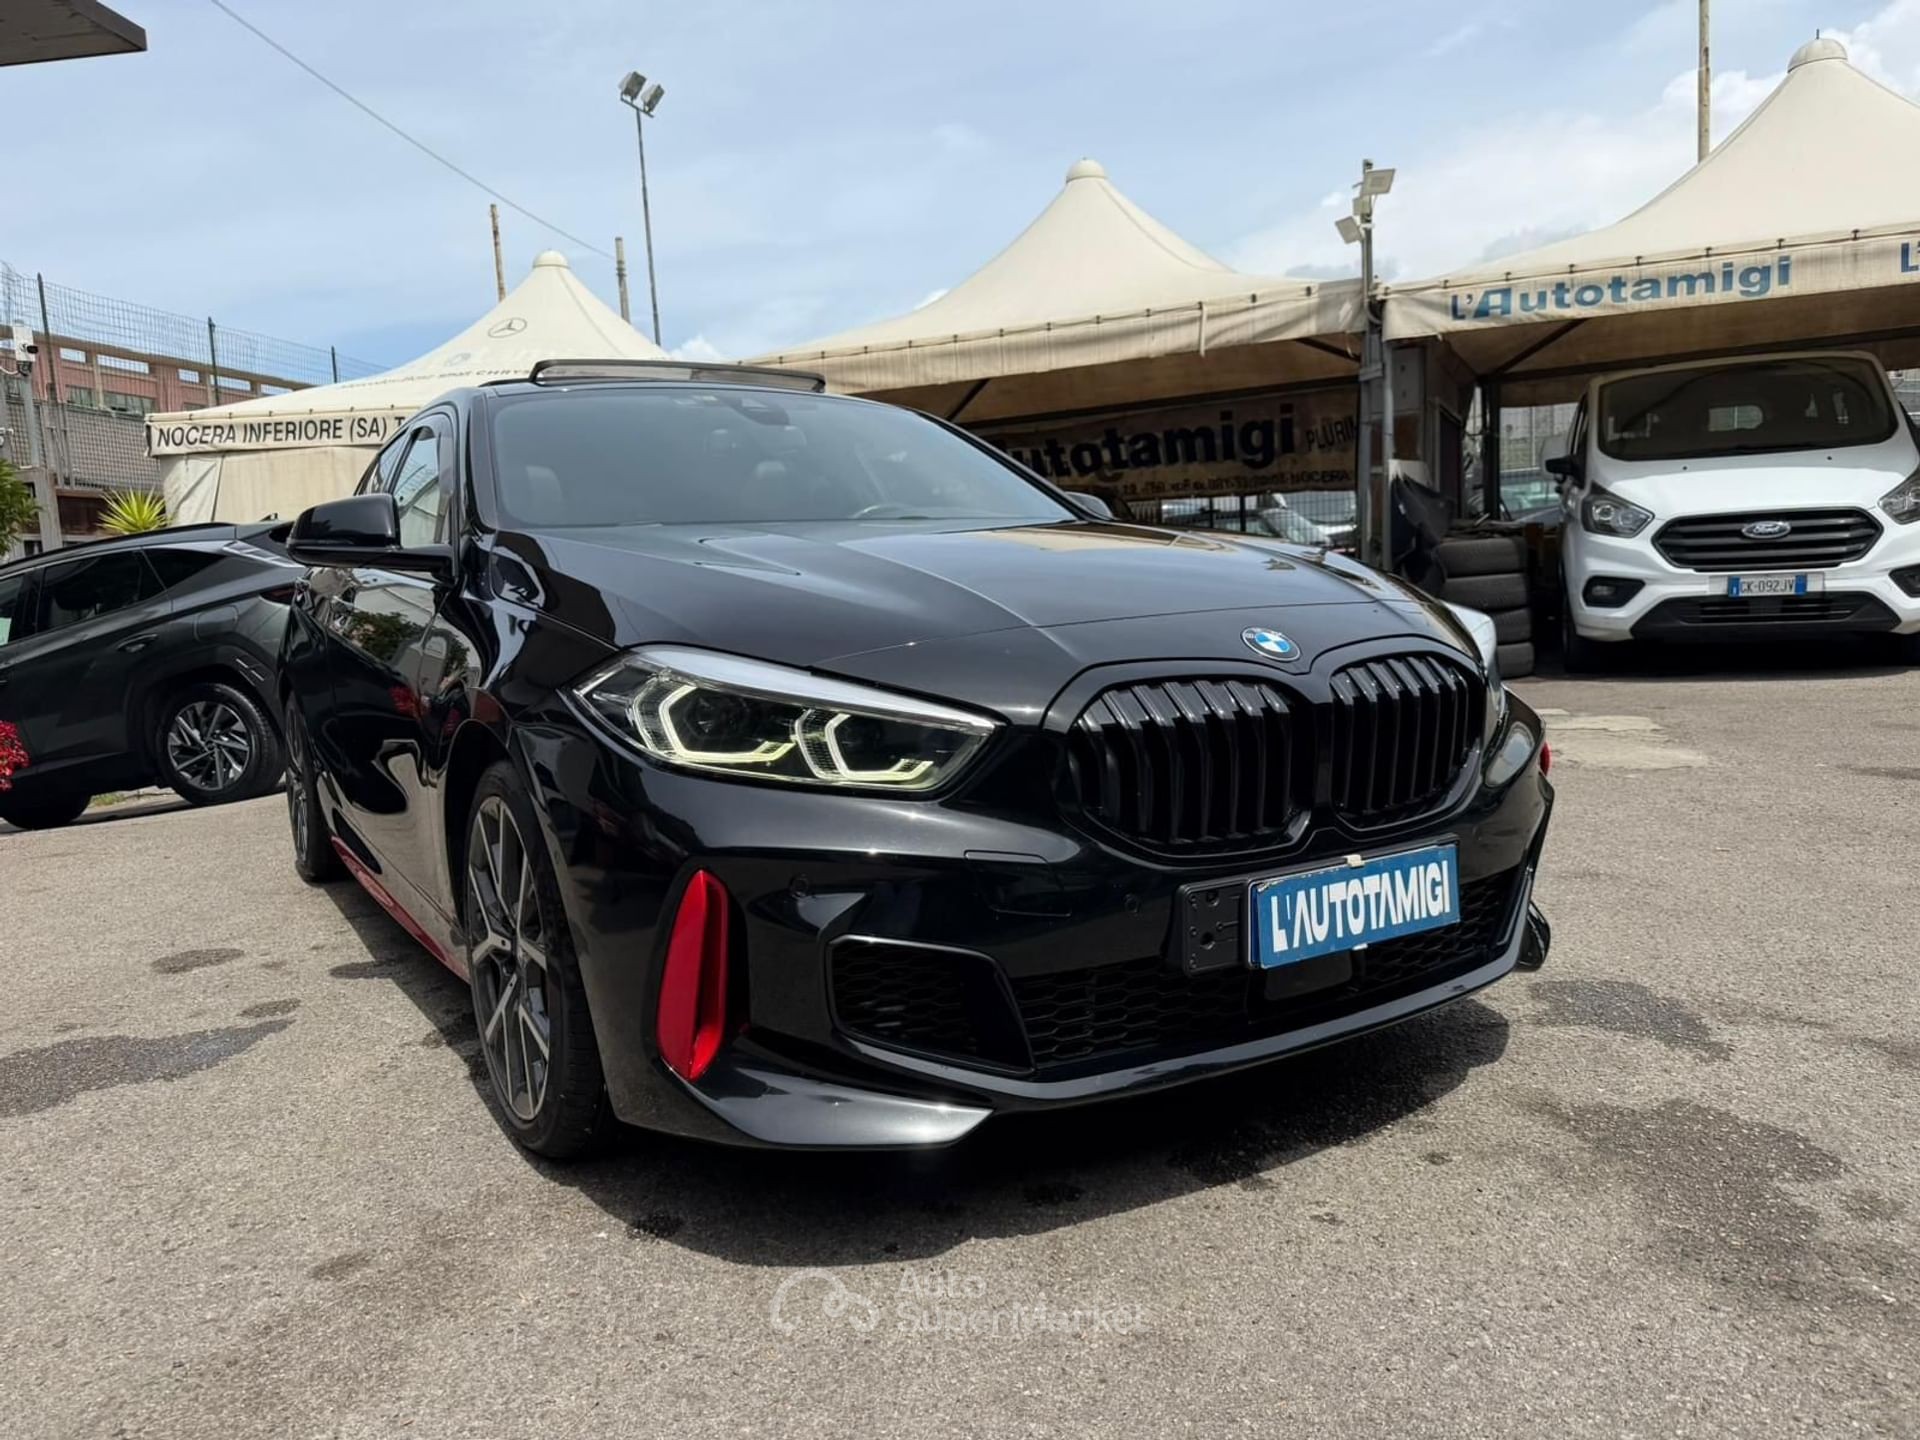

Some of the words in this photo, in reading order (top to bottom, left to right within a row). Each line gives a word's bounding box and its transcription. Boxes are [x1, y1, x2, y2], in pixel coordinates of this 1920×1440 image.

[1451, 255, 1792, 321] L'Autotamigi
[157, 424, 236, 448] NOCERA
[243, 418, 343, 444] INFERIORE
[350, 416, 387, 442] (SA)
[990, 403, 1296, 478] utotamigi
[1271, 860, 1450, 953] L'AUTOTAMIGI
